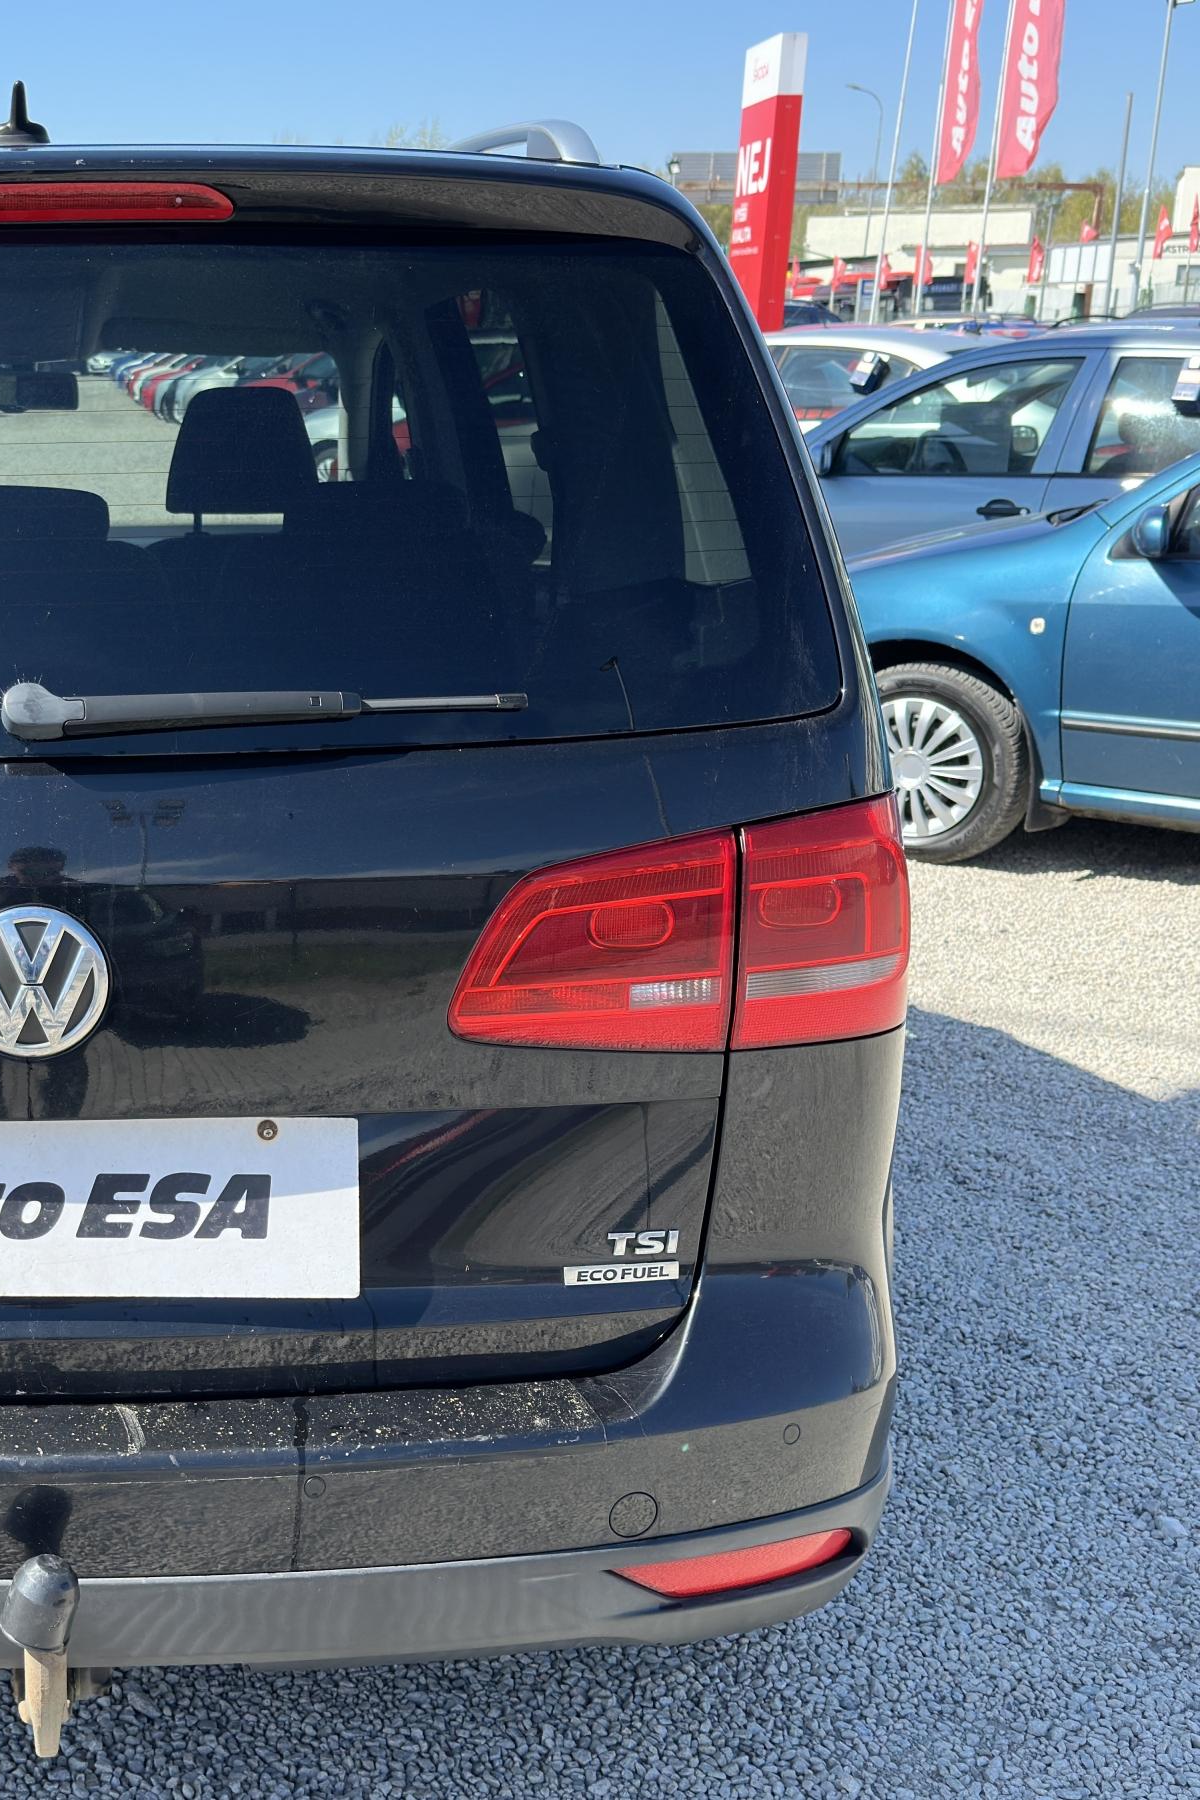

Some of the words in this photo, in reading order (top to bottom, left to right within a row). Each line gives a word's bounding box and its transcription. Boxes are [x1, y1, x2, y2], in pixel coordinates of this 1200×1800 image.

[951, 39, 970, 159] Auto
[1016, 22, 1040, 154] Auto
[735, 137, 772, 198] NEJ
[75, 1171, 273, 1241] ESA
[607, 1230, 680, 1256] TSI
